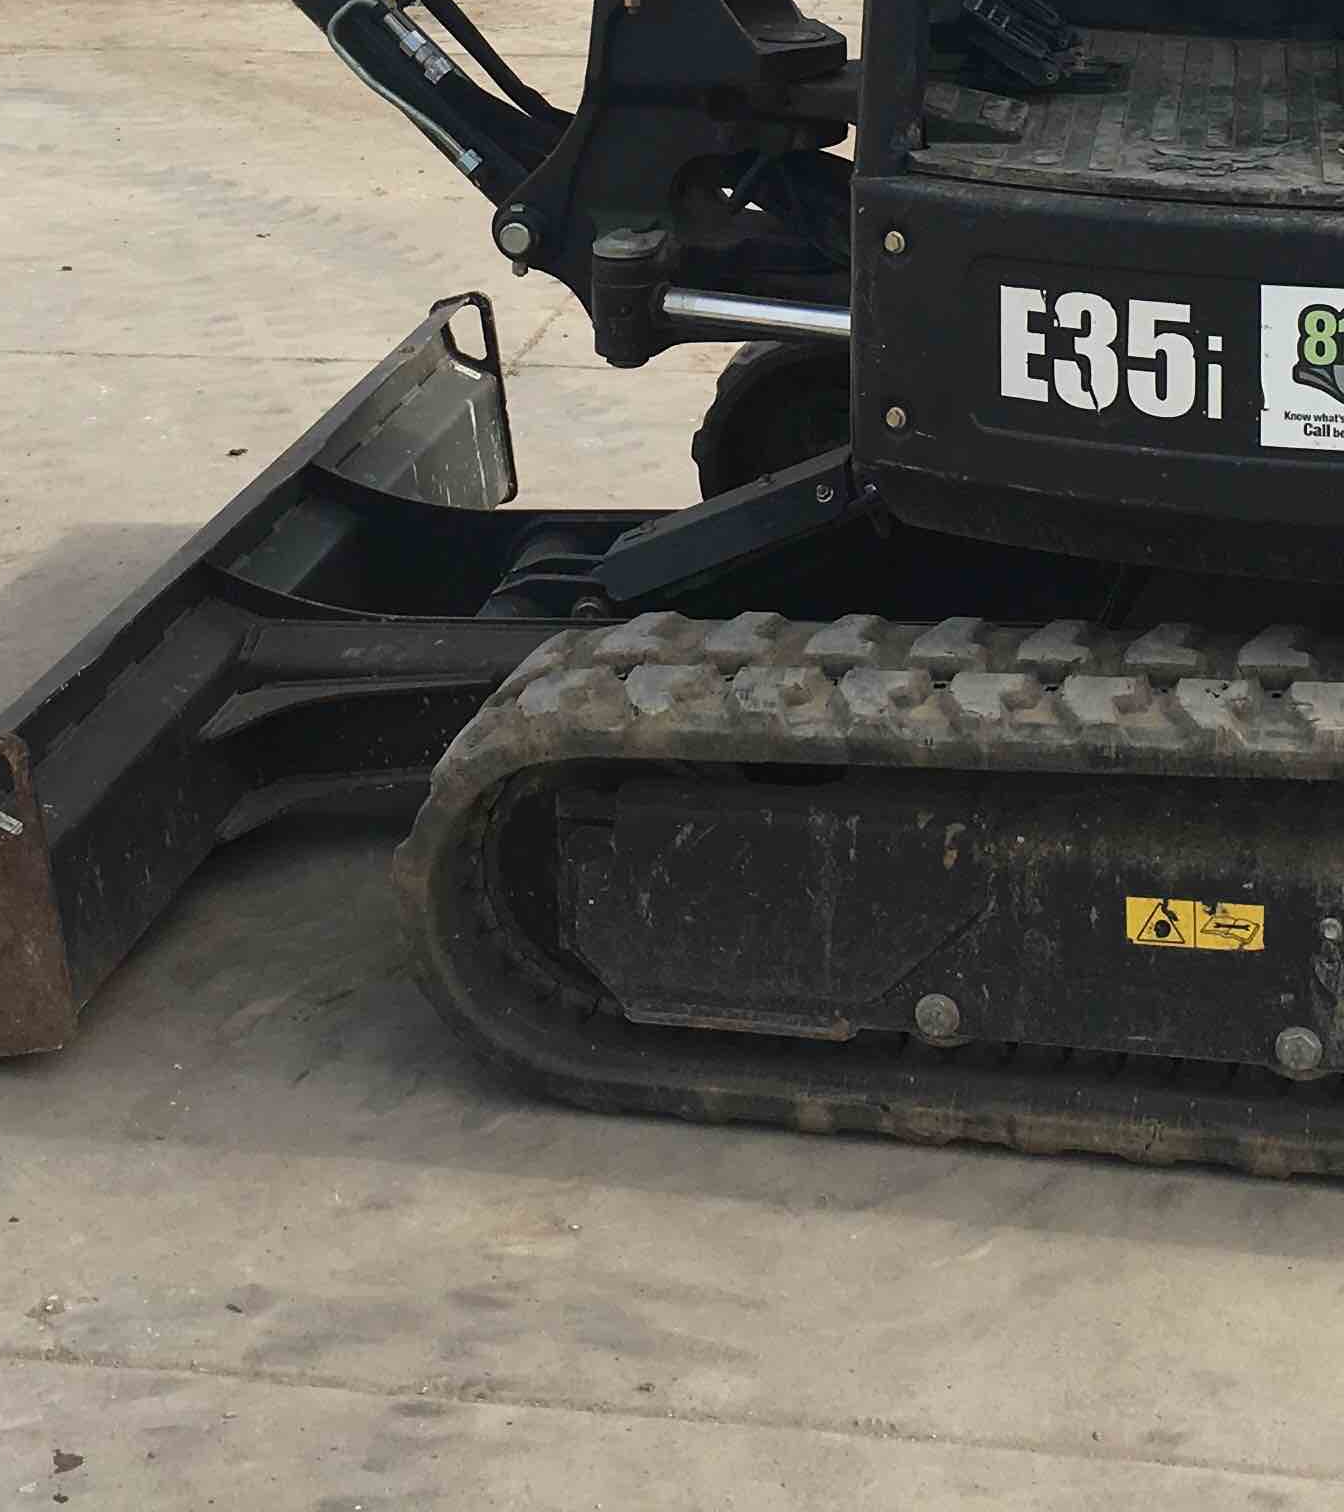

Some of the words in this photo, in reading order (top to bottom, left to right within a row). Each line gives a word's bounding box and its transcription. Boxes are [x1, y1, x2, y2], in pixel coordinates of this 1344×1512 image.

[1000, 284, 1223, 420] E35i
[1283, 410, 1312, 422] Know
[1303, 422, 1331, 438] Call
